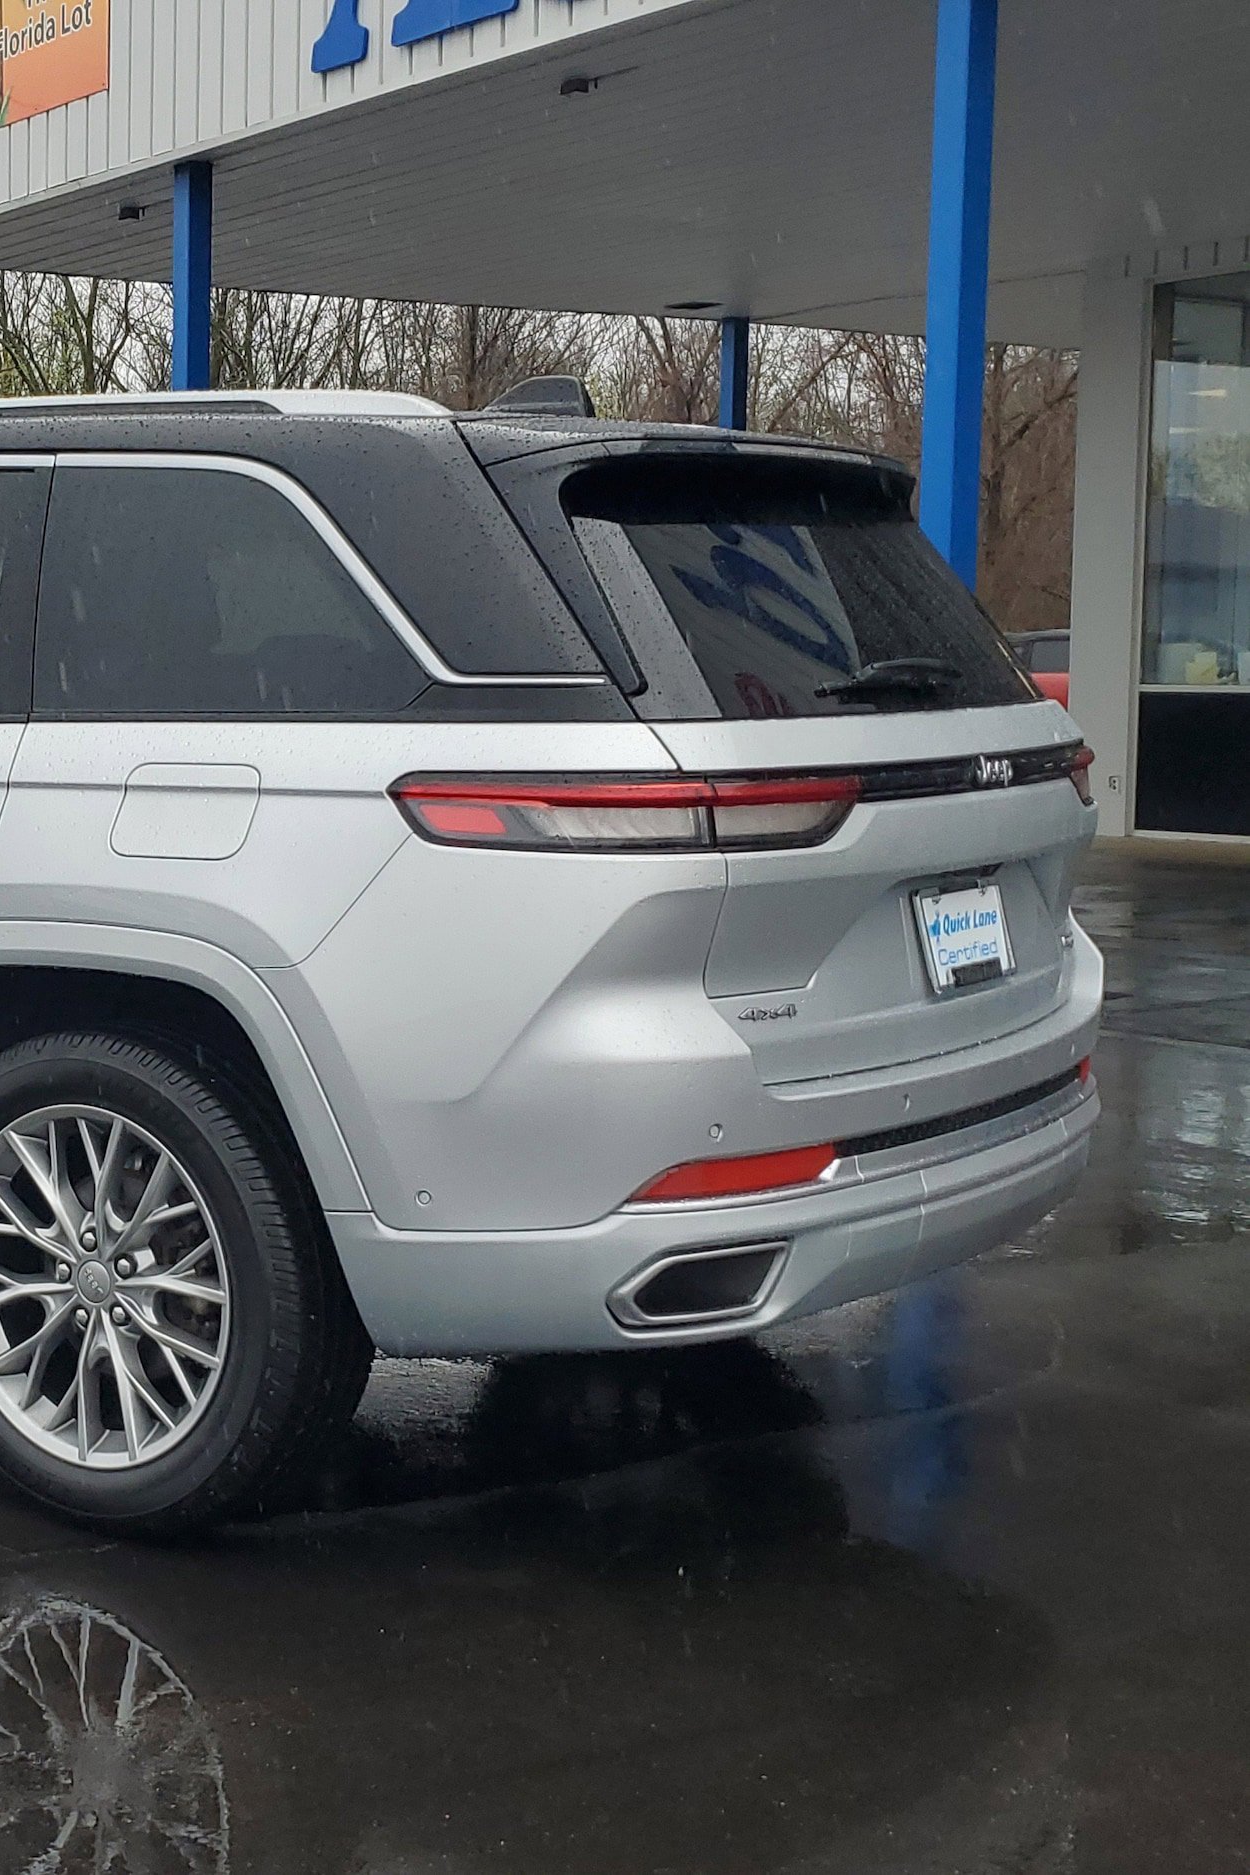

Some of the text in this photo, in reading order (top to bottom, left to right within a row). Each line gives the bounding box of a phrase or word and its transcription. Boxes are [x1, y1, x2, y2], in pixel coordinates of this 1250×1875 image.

[61, 0, 92, 35] Lot
[942, 909, 998, 936] Quick Lane
[937, 937, 999, 967] Certified
